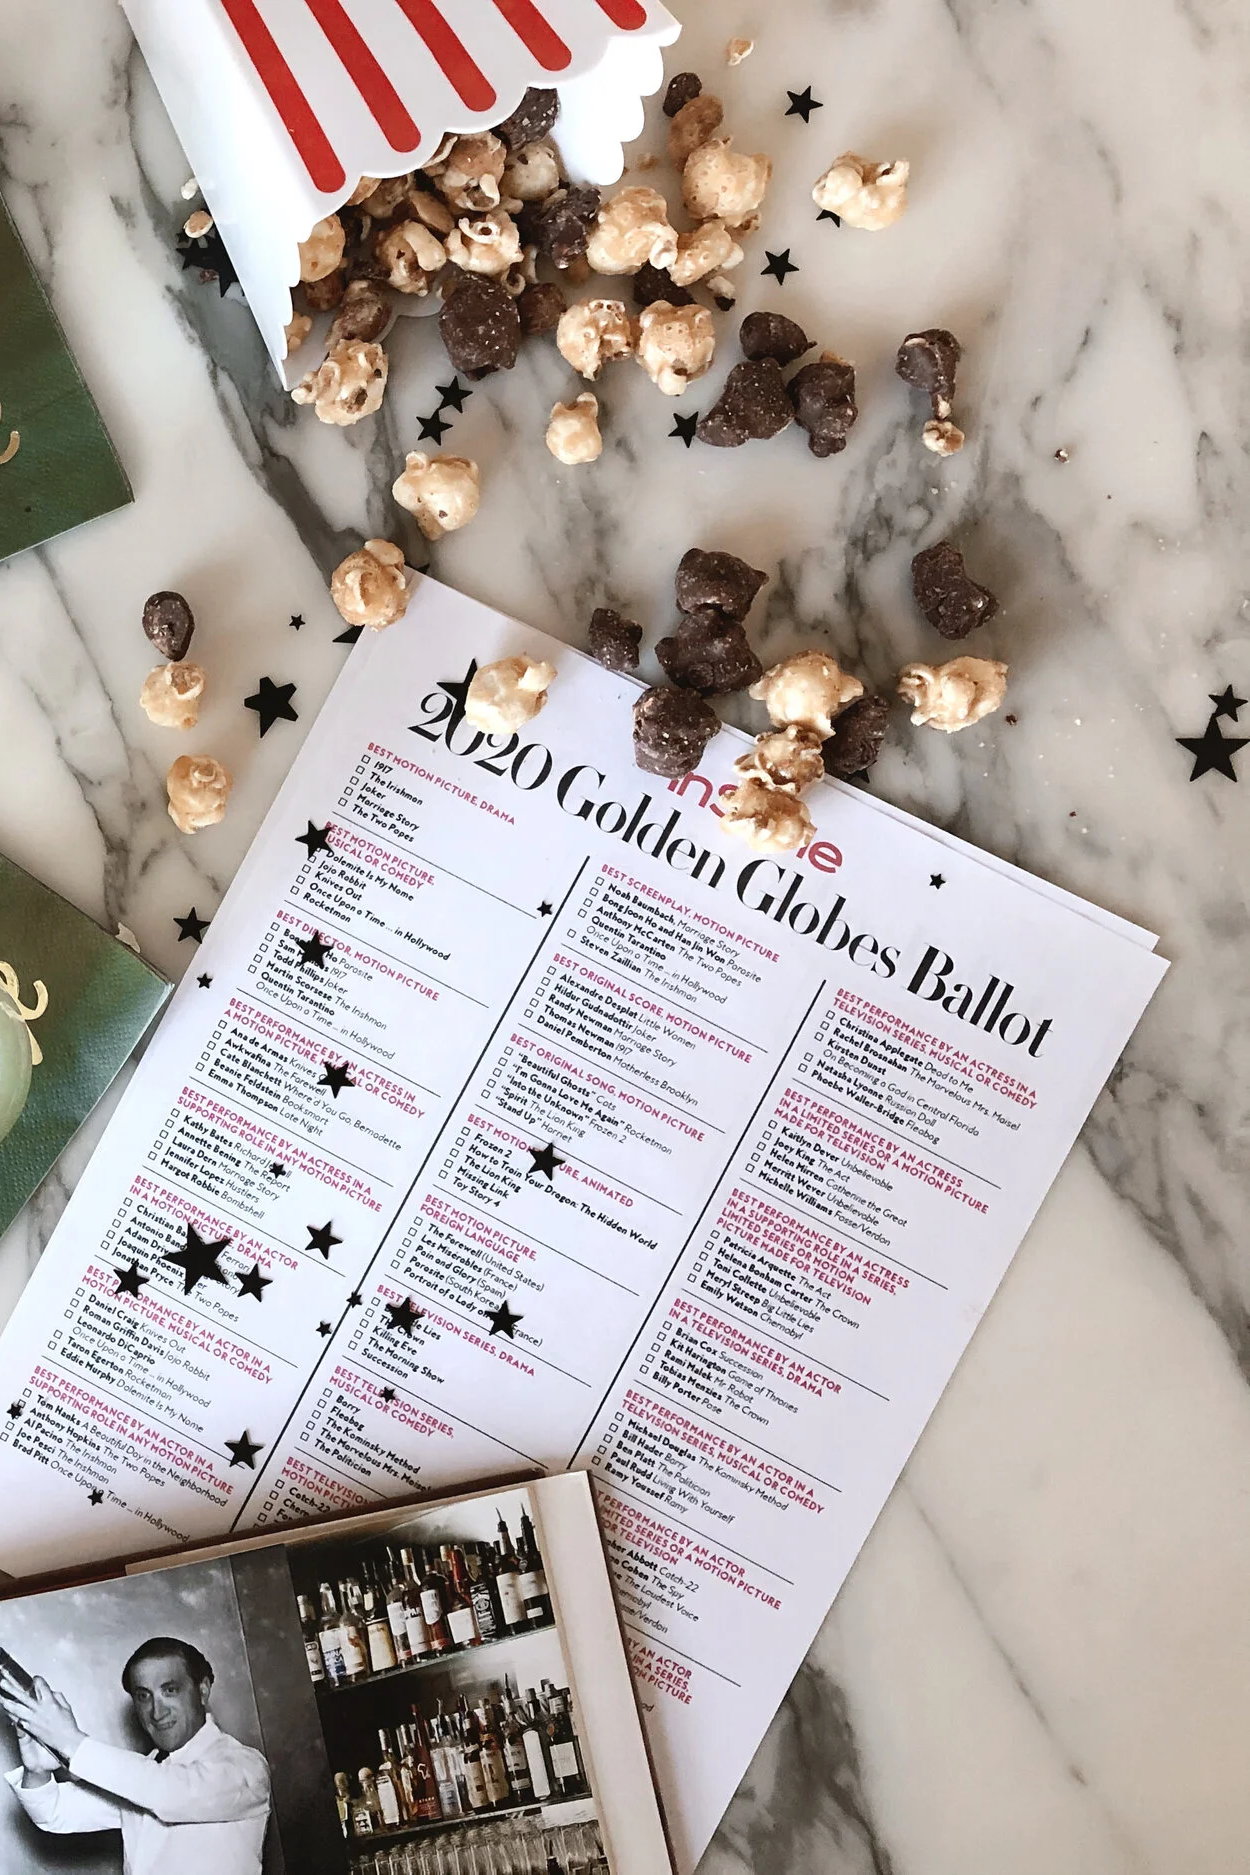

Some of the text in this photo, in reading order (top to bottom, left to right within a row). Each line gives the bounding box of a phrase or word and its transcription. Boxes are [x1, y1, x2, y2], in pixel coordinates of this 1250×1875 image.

[356, 793, 420, 832] Marriage Story
[359, 782, 387, 800] Joker
[367, 741, 394, 760] BEST
[392, 755, 435, 782] MOTION
[479, 800, 515, 826] DRAMA
[369, 770, 423, 806] The Irishman
[352, 803, 415, 843] The Two Popes
[314, 870, 363, 901] Knives Out
[317, 860, 367, 890] Jojo Rabbit
[408, 692, 553, 791] 2020
[556, 765, 726, 889] Golden
[736, 859, 901, 979] Globes
[906, 945, 1053, 1058] Ballot
[302, 891, 351, 923] Rocketman
[601, 863, 628, 882] BEST
[692, 912, 736, 940] MOTION
[734, 933, 780, 963] PICTURE
[595, 905, 742, 987] Anthony McCarten The Two Popes
[260, 971, 335, 1016] Quentin Tarantino
[552, 952, 580, 972] BEST
[579, 967, 627, 999] ORIGINAL
[665, 1012, 708, 1040] MOTION
[707, 1034, 753, 1064] PICTURE
[559, 973, 696, 1050] Alexandre Desplat Little Women
[536, 1014, 699, 1106] Daniel Pemberton Motherless Brooklyn
[833, 996, 892, 1035] TELEVISION
[928, 1048, 974, 1079] MUSICAL
[975, 1073, 992, 1087] OR
[992, 1081, 1038, 1110] COMEDY
[839, 1017, 974, 1094] Christina Applegate Dead to Me
[213, 1057, 329, 1126] Beanie Feldstein Booksmart
[595, 1095, 617, 1111] Cats
[810, 1069, 940, 1146] Phoebe Waller-Bridge Fleabag
[177, 1095, 383, 1213] SUPPORTING ROLE IN ANY MOTION PICTURE
[473, 1132, 513, 1159] Frozen 2
[773, 1107, 886, 1171] MADE FOR TELEVISION
[780, 1125, 894, 1192] Kaitlyn Dever Unbelievable
[160, 1157, 265, 1219] Margot Robbie Bombshell
[164, 1146, 260, 1203] Jennifer Lopez Hustlers
[452, 1175, 501, 1208] Toy Story 4
[456, 1165, 510, 1199] Missing Link
[464, 1154, 522, 1194] The Lion King
[419, 1203, 521, 1264] FOREIGN LANGUAGE
[721, 1206, 856, 1285] LIMITED SERIES OR MOTION
[420, 1234, 437, 1248] Les
[483, 1267, 518, 1292] (France)
[88, 1293, 186, 1354] Daniel Craig Knives Out
[700, 1279, 805, 1340] Emily Watson Chernobyl
[67, 1335, 172, 1401] Taron Egerton Rocketman
[361, 1347, 409, 1379] Succession
[367, 1336, 445, 1384] The Morning Show
[372, 1325, 418, 1356] Killing Eve
[675, 1326, 764, 1381] Brian Cox Succession
[329, 1405, 365, 1432] Fleabag
[335, 1394, 362, 1415] Barry
[652, 1370, 723, 1415] Billy Porter Pose
[29, 1407, 166, 1487] Anthony Hopkins The Two Popes
[314, 1437, 372, 1477] The Politician
[627, 1418, 790, 1511] Michael Douglas The Kominsky Method
